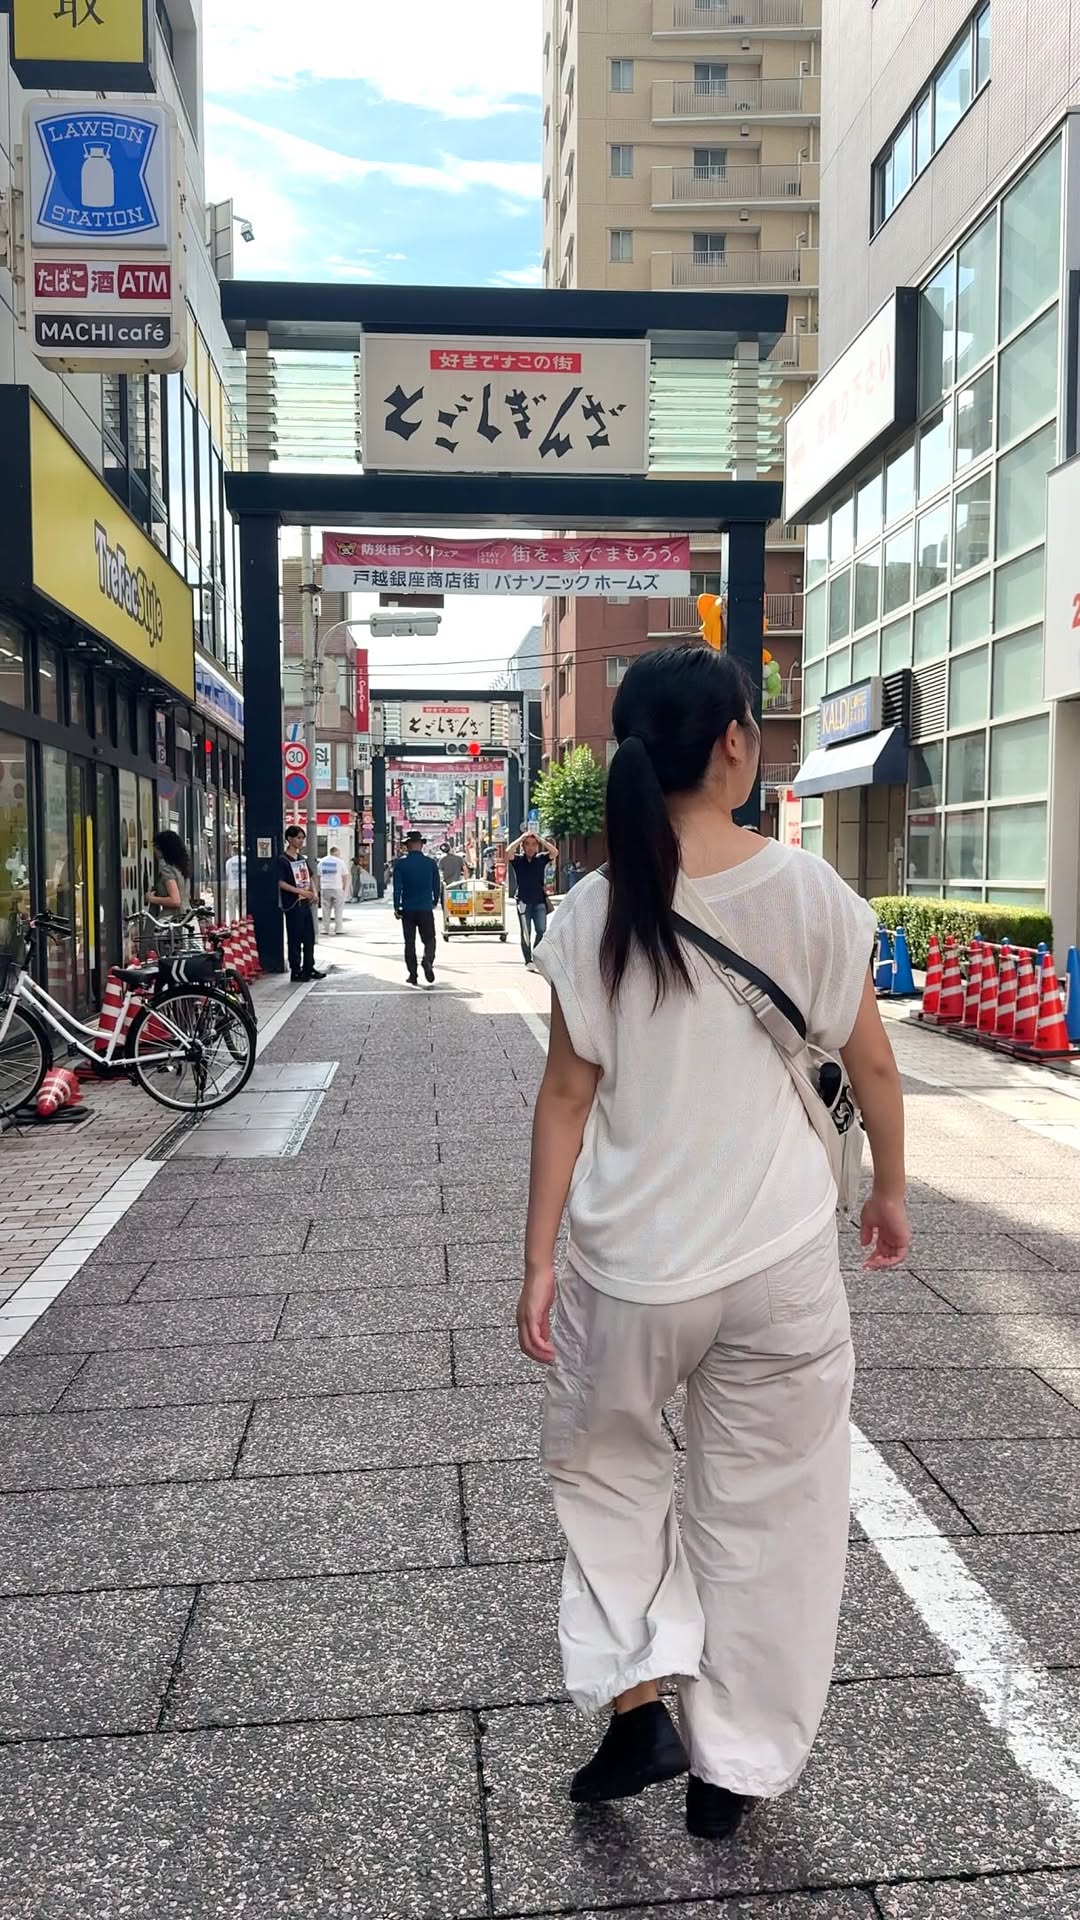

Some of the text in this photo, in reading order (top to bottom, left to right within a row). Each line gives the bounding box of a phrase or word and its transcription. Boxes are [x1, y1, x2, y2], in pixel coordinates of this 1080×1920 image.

[48, 121, 145, 144] LAWSON
[51, 205, 145, 227] STATION
[38, 268, 86, 292] たばこ
[91, 270, 115, 293] 酒
[121, 271, 168, 293] ATM
[41, 322, 165, 341] MACHI café
[438, 352, 573, 371] 好きですこの街
[384, 382, 627, 459] とごしぎんざ
[511, 544, 681, 564] 街を、家でまもろう。
[94, 518, 164, 648] TreFacStyle
[352, 569, 480, 589] 戸越銀座商店街
[494, 573, 660, 591] パナソニック ホームズ
[821, 696, 850, 735] KALDI
[288, 750, 304, 764] 30
